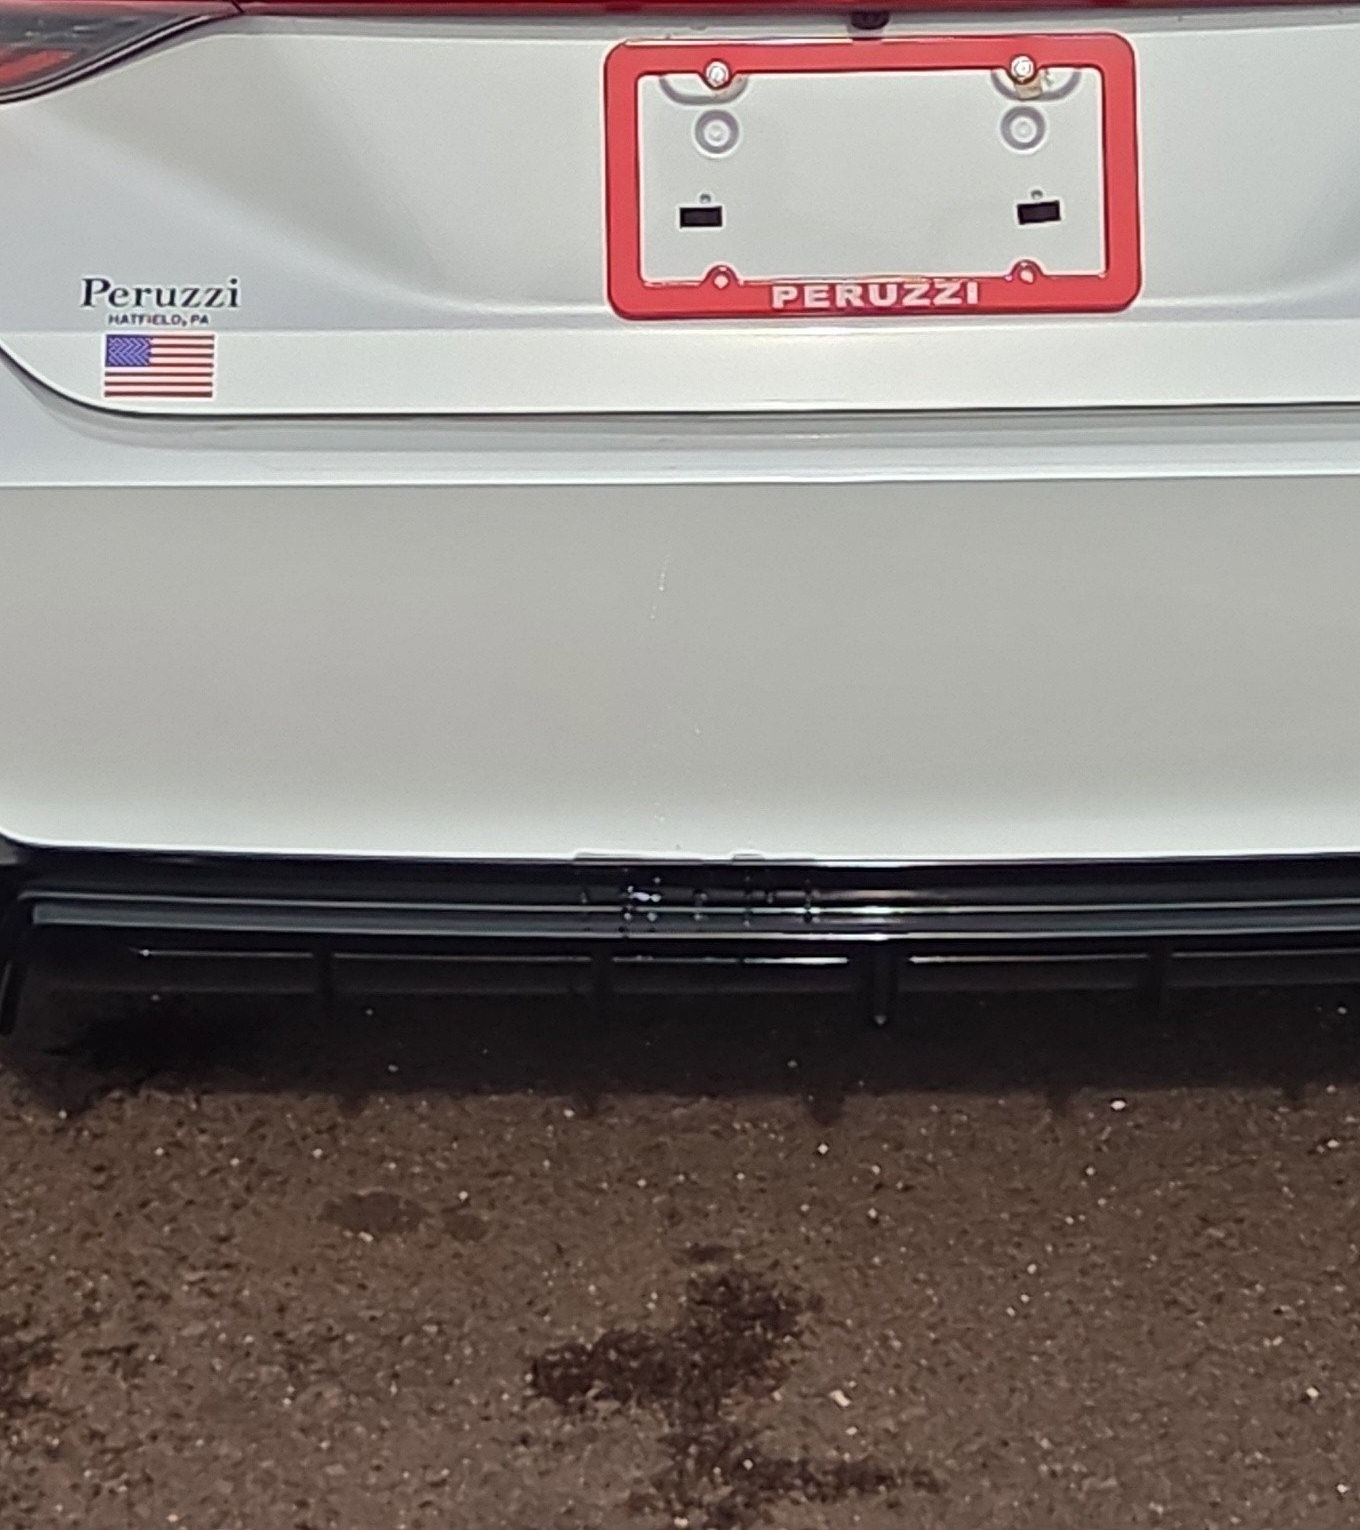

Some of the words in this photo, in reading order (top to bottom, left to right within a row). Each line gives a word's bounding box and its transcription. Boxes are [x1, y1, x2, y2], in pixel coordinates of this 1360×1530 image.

[80, 277, 241, 308] Peruzzi
[771, 281, 979, 309] PERUZZI
[190, 314, 210, 326] PA
